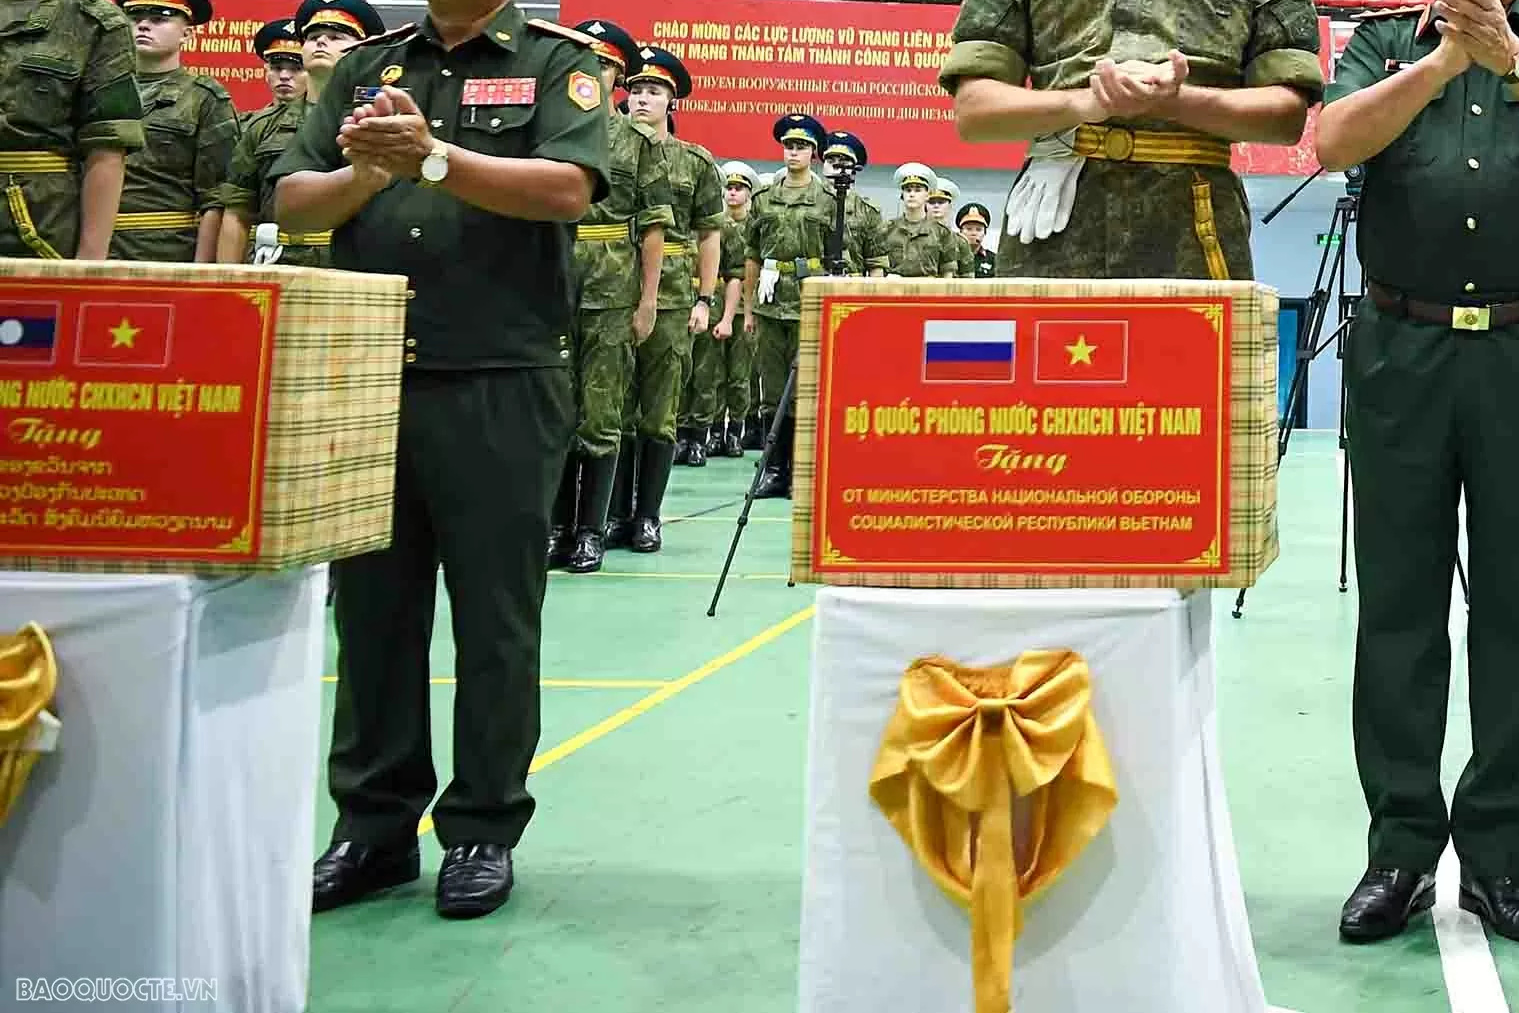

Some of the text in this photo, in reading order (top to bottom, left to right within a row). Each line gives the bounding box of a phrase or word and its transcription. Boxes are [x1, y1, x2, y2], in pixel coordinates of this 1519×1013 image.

[200, 36, 242, 53] NGHĨA
[653, 20, 689, 38] CHÀO
[692, 20, 731, 40] MỪNG
[734, 21, 761, 42] CÁC
[763, 24, 788, 45] LỰC
[792, 26, 835, 46] LƯỢNG
[838, 26, 855, 45] VŨ
[858, 29, 900, 48] TRANG
[903, 29, 933, 49] LIÊN
[688, 43, 728, 64] MẠNG
[731, 42, 774, 62] THÁNG
[777, 44, 805, 64] TÁM
[808, 46, 852, 66] THÀNH
[854, 48, 891, 68] CÔNG
[894, 47, 911, 68] VÀ
[739, 76, 829, 94] ВООРУЖЕННЫЕ
[832, 81, 867, 95] СИЛЫ
[682, 99, 727, 113] ПОБЕДЫ
[728, 99, 814, 116] АВГУСТОВСКОЙ
[25, 374, 76, 409] NƯỚC
[80, 382, 152, 411] CHXHCN
[157, 377, 195, 418] VIỆT
[198, 384, 242, 413] NAM
[844, 397, 1202, 442] BỘ QUỐC PHÒNG NƯỚC CHXHCN VIỆT NAM
[8, 417, 103, 449] Tặng
[974, 443, 1068, 477] Tặng
[843, 487, 1201, 506] ОТ МИНИСТЕРСТВА НАЦИОНАЛЬНОЙ ОБОРОНЫ
[851, 512, 1193, 532] СОЦИАЛИСТИЧЕСКОЙ РЕСПУБЛИКИ ВЬЕТНАМ
